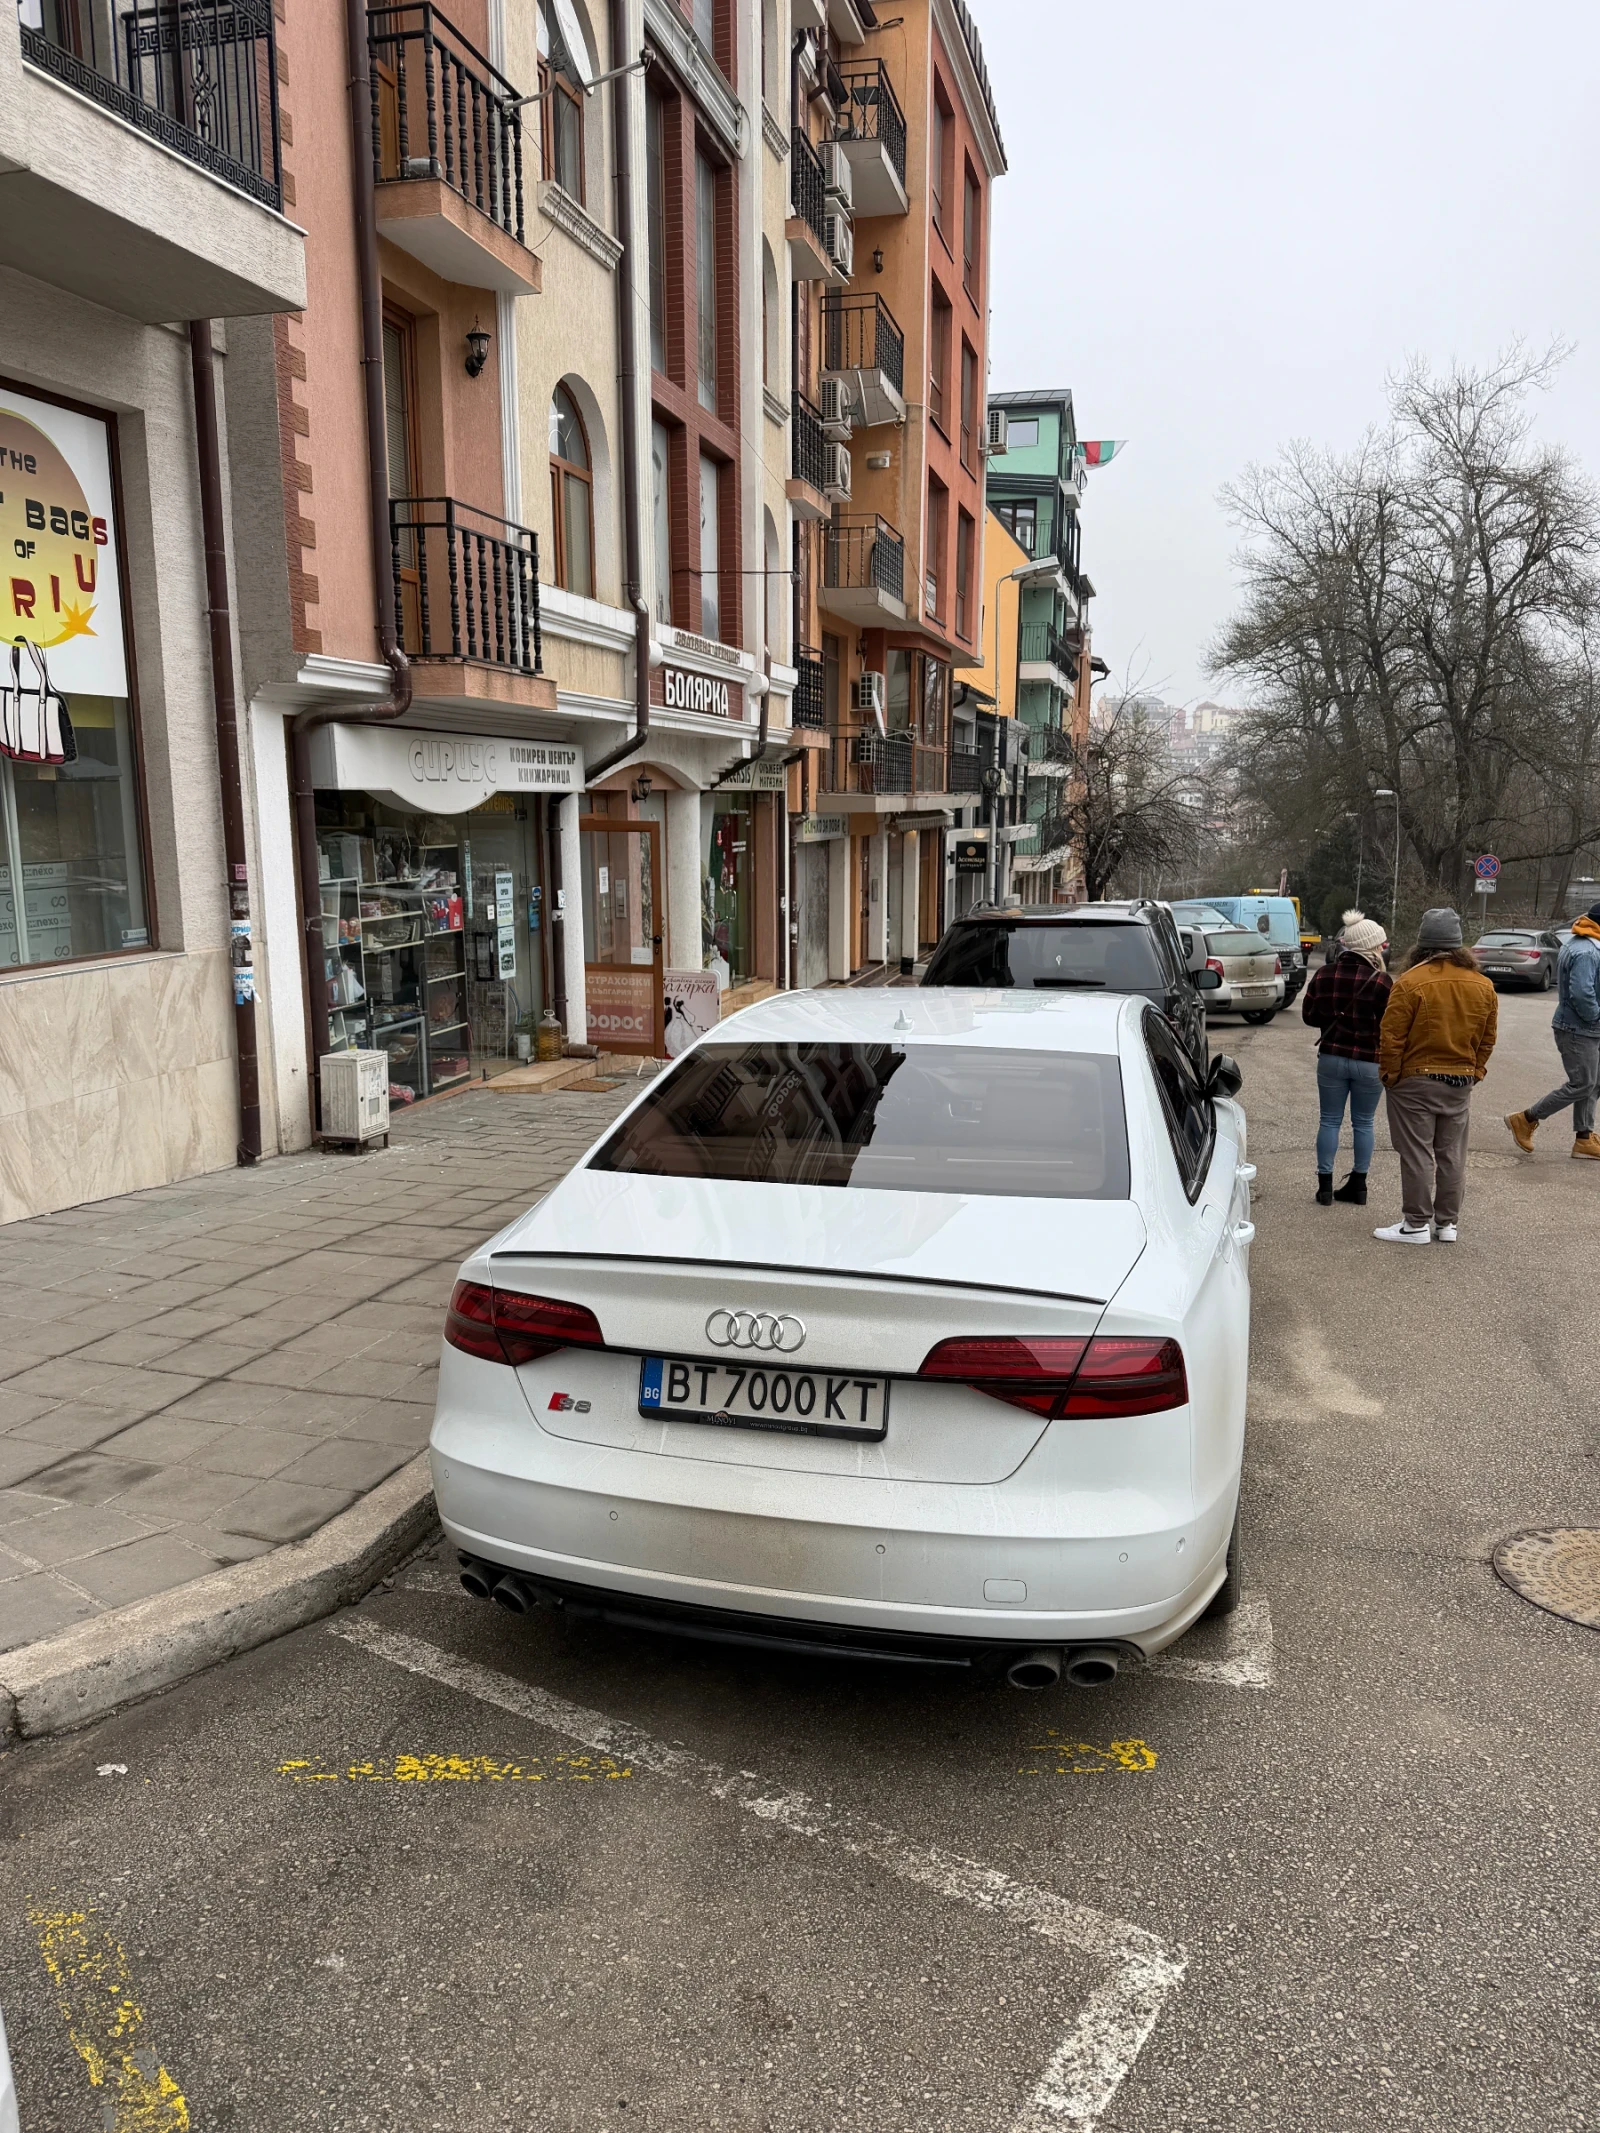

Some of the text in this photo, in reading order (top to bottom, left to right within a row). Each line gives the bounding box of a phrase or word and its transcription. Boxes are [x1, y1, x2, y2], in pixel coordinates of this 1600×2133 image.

[14, 539, 36, 559] OF
[664, 669, 729, 716] БОЛЯРКА
[509, 747, 576, 765] КОПИРЕН ЦЕНТЪР
[518, 768, 571, 784] КНИЖАРНИЦА
[37, 917, 59, 927] nexo
[586, 976, 651, 987] СТРАХОВКИ
[592, 988, 632, 996] БЪЛГАРИЯ
[644, 1387, 660, 1399] BG
[556, 1396, 592, 1414] S8
